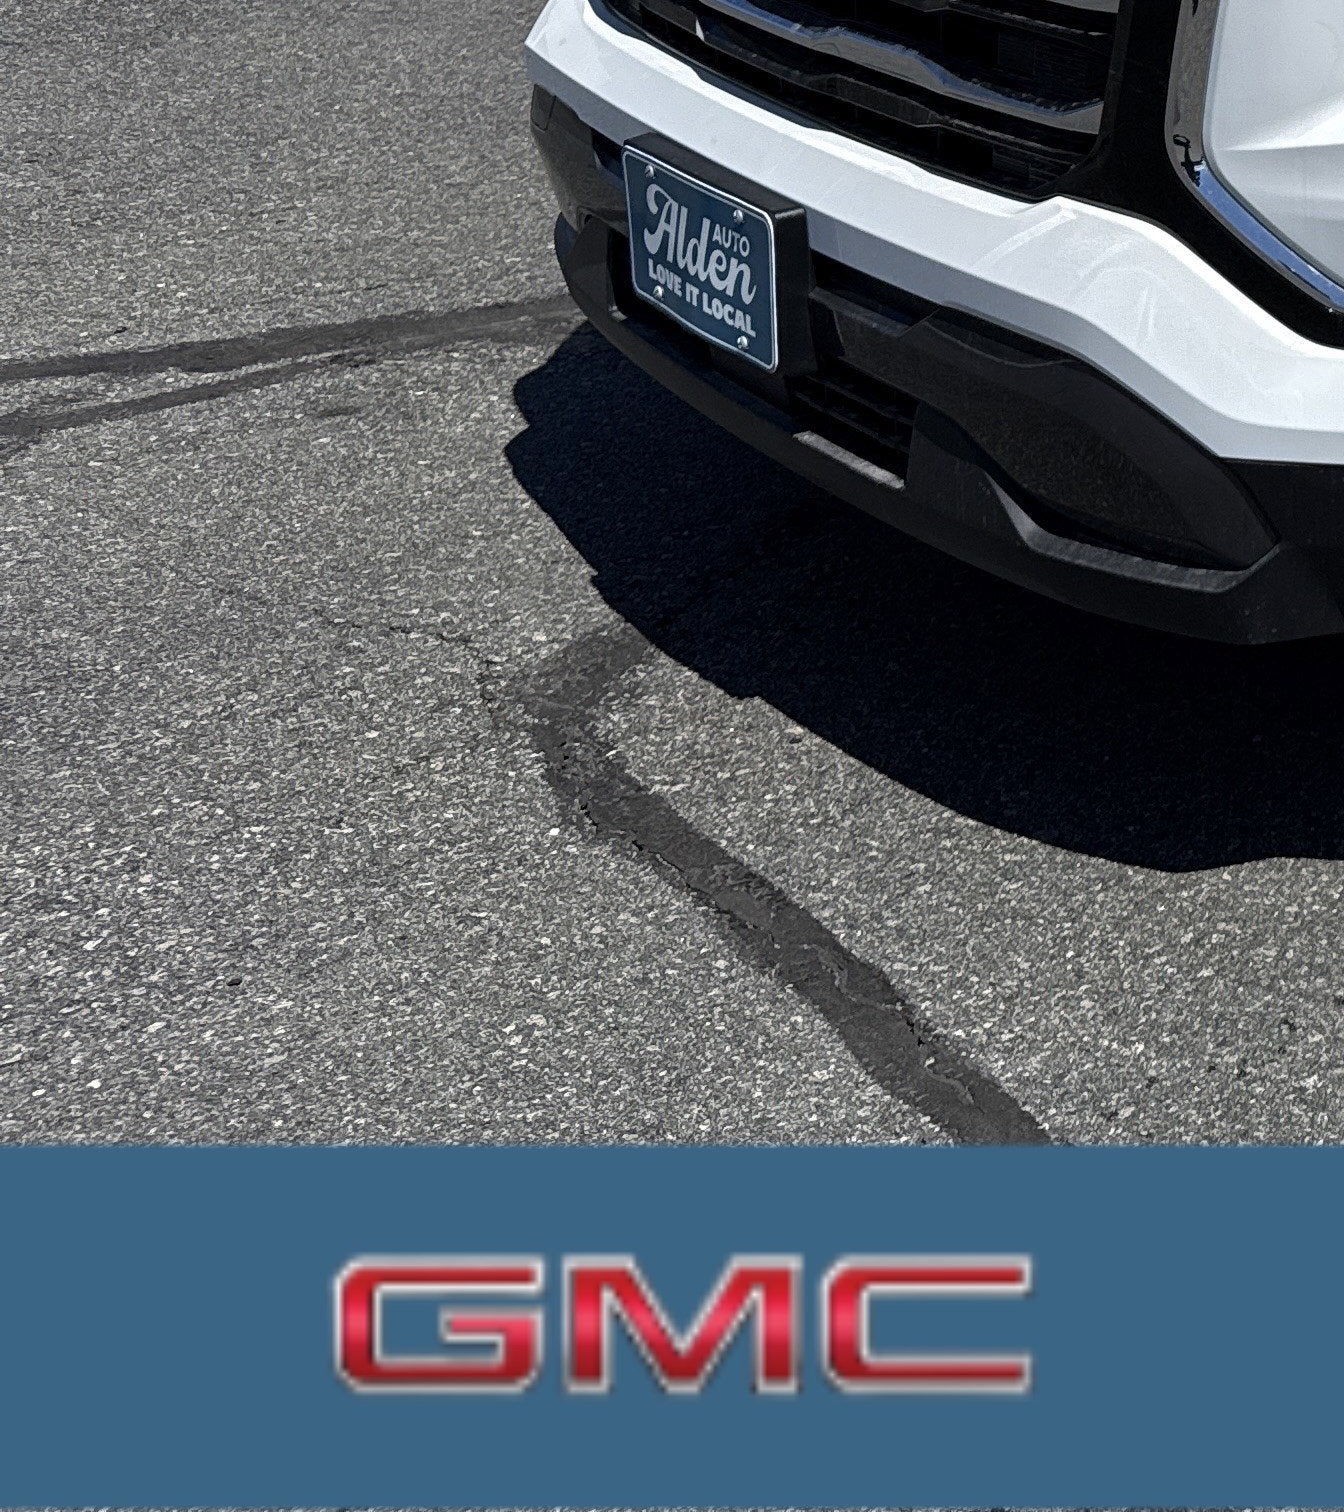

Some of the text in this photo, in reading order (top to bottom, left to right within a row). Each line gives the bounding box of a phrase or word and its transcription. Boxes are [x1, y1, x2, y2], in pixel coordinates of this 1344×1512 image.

[643, 184, 757, 305] Alden
[711, 223, 751, 258] AUTO
[648, 258, 757, 338] LOVE IT LOCAL
